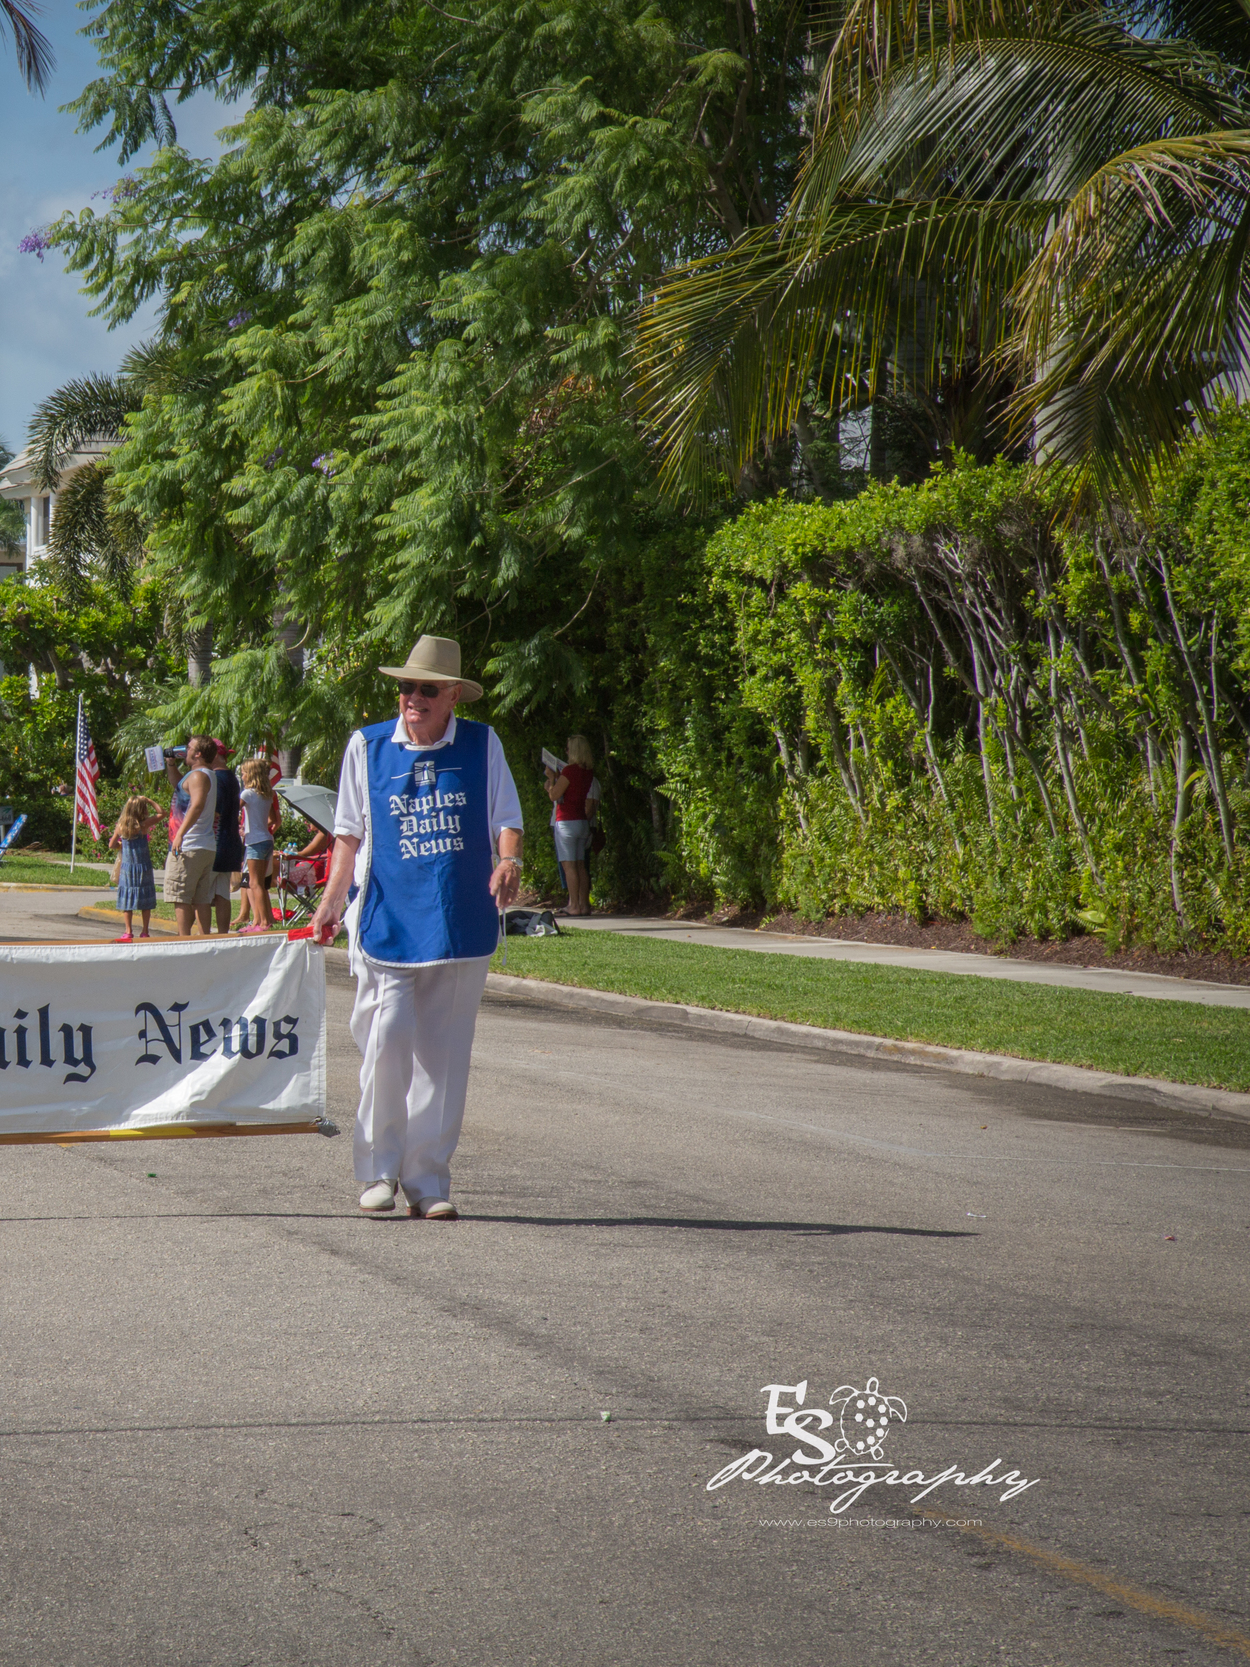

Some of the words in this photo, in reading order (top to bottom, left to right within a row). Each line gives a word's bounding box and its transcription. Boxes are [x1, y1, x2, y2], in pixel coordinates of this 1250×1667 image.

[389, 788, 467, 816] Naples
[399, 810, 461, 836] Daily
[398, 837, 464, 860] News
[134, 1001, 300, 1066] News
